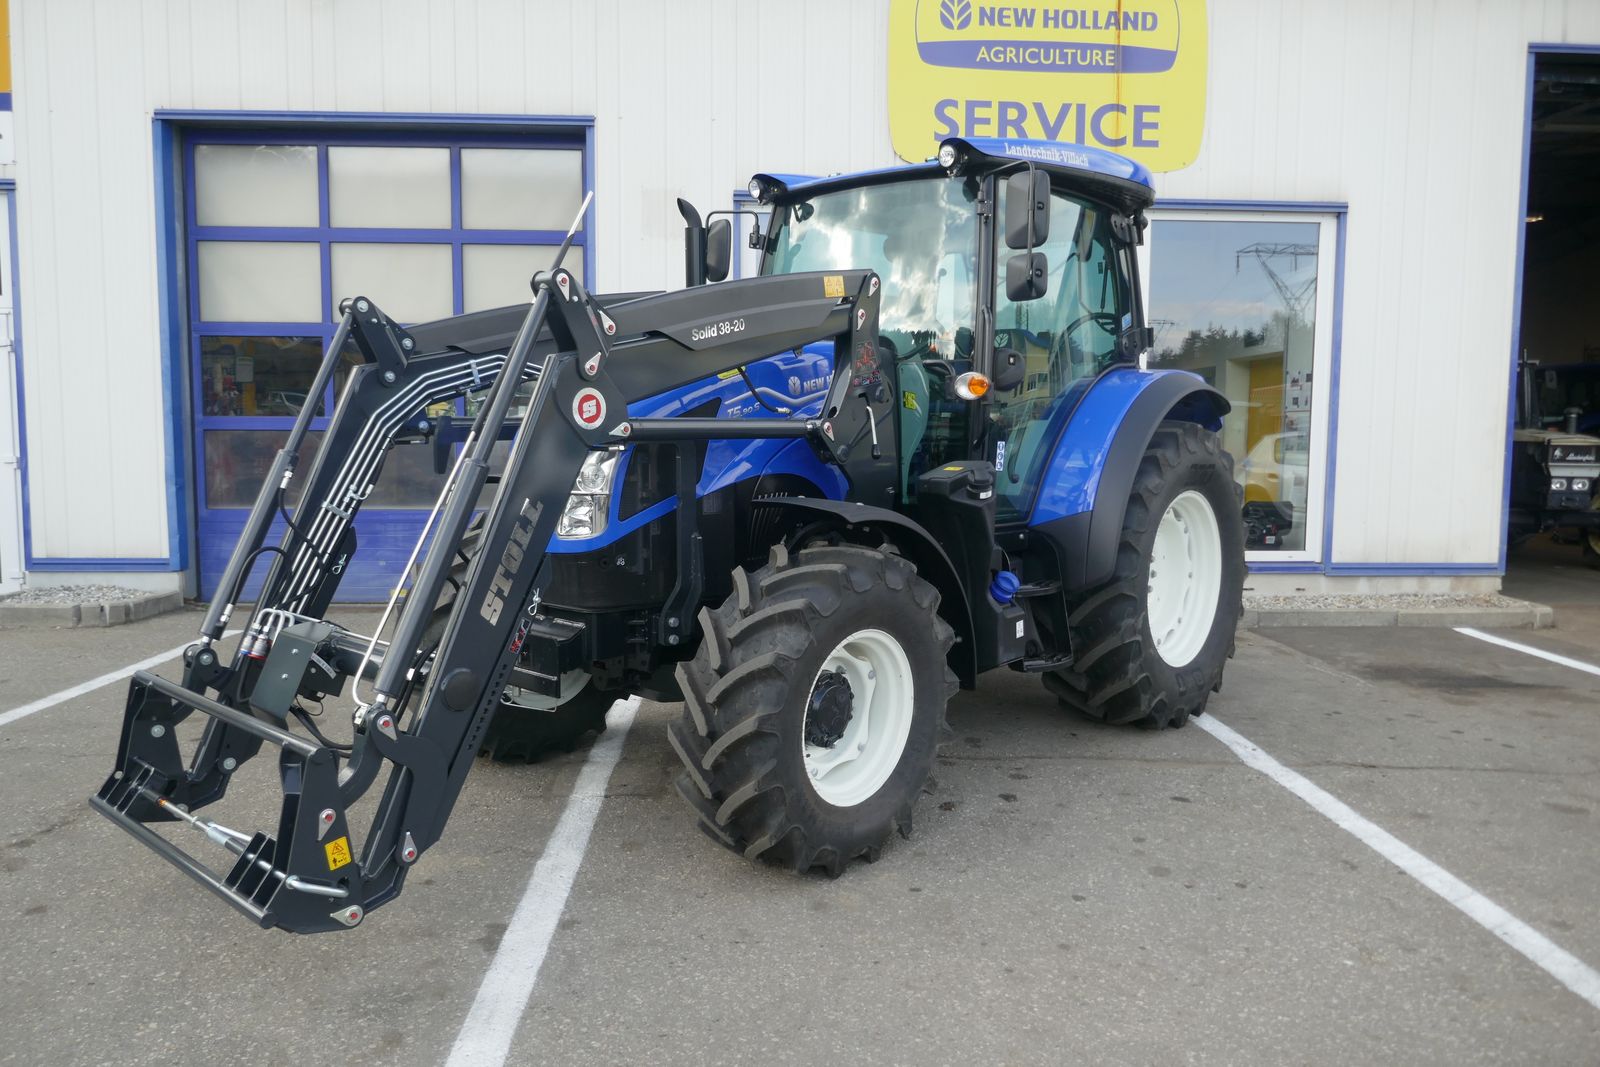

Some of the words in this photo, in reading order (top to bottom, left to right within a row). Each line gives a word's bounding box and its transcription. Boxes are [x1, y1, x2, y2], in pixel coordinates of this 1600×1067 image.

[979, 6, 1039, 30] NEW
[1042, 7, 1159, 32] HOLLAND
[976, 46, 1116, 66] AGRICULTURE
[933, 98, 1161, 148] SERVICE
[1004, 142, 1089, 167] Landtechnik-Villach
[691, 324, 718, 341] Solid
[718, 318, 746, 336] 38-20
[803, 376, 824, 393] NEW
[480, 497, 545, 627] STOLL
